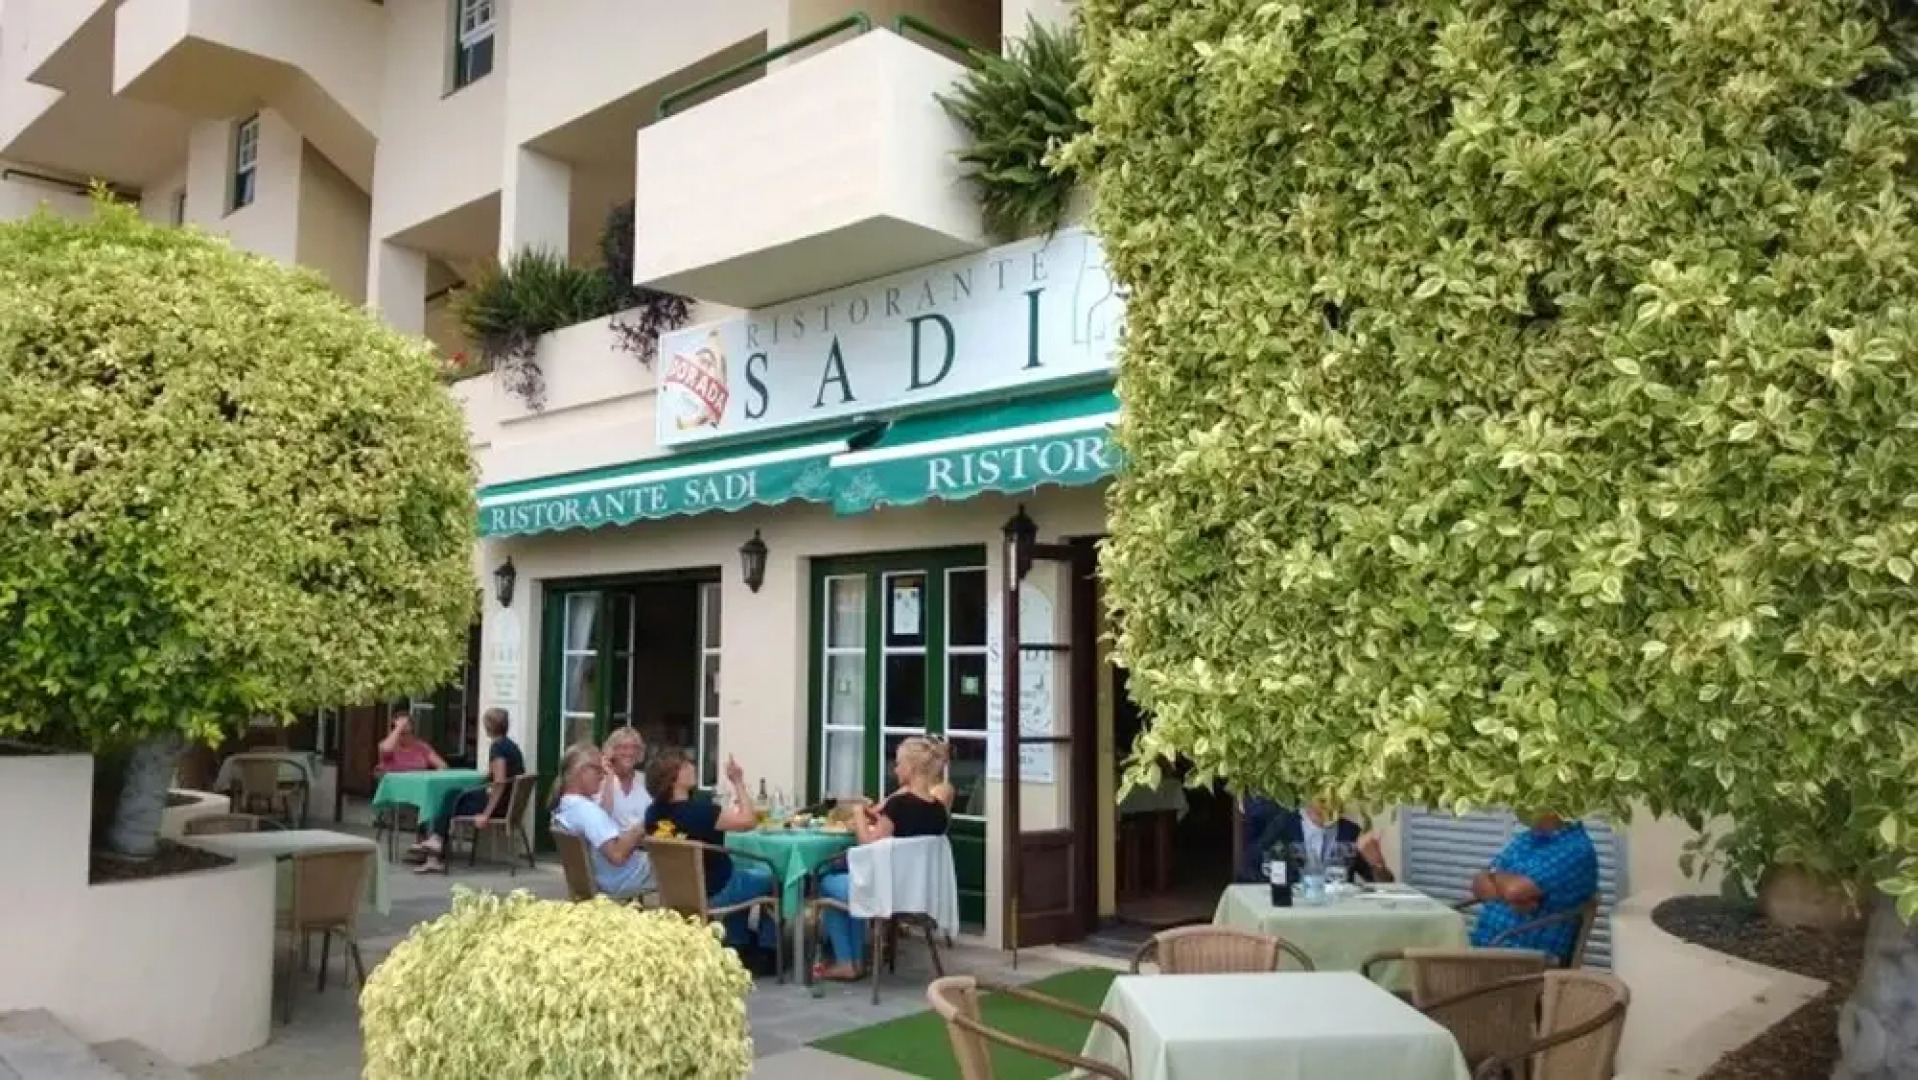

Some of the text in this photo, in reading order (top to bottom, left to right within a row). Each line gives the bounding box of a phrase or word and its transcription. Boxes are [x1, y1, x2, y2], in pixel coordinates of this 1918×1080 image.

[745, 252, 1048, 348] RISTORANTE
[744, 287, 1045, 419] SADI
[491, 470, 757, 531] RISTORANTE SADI
